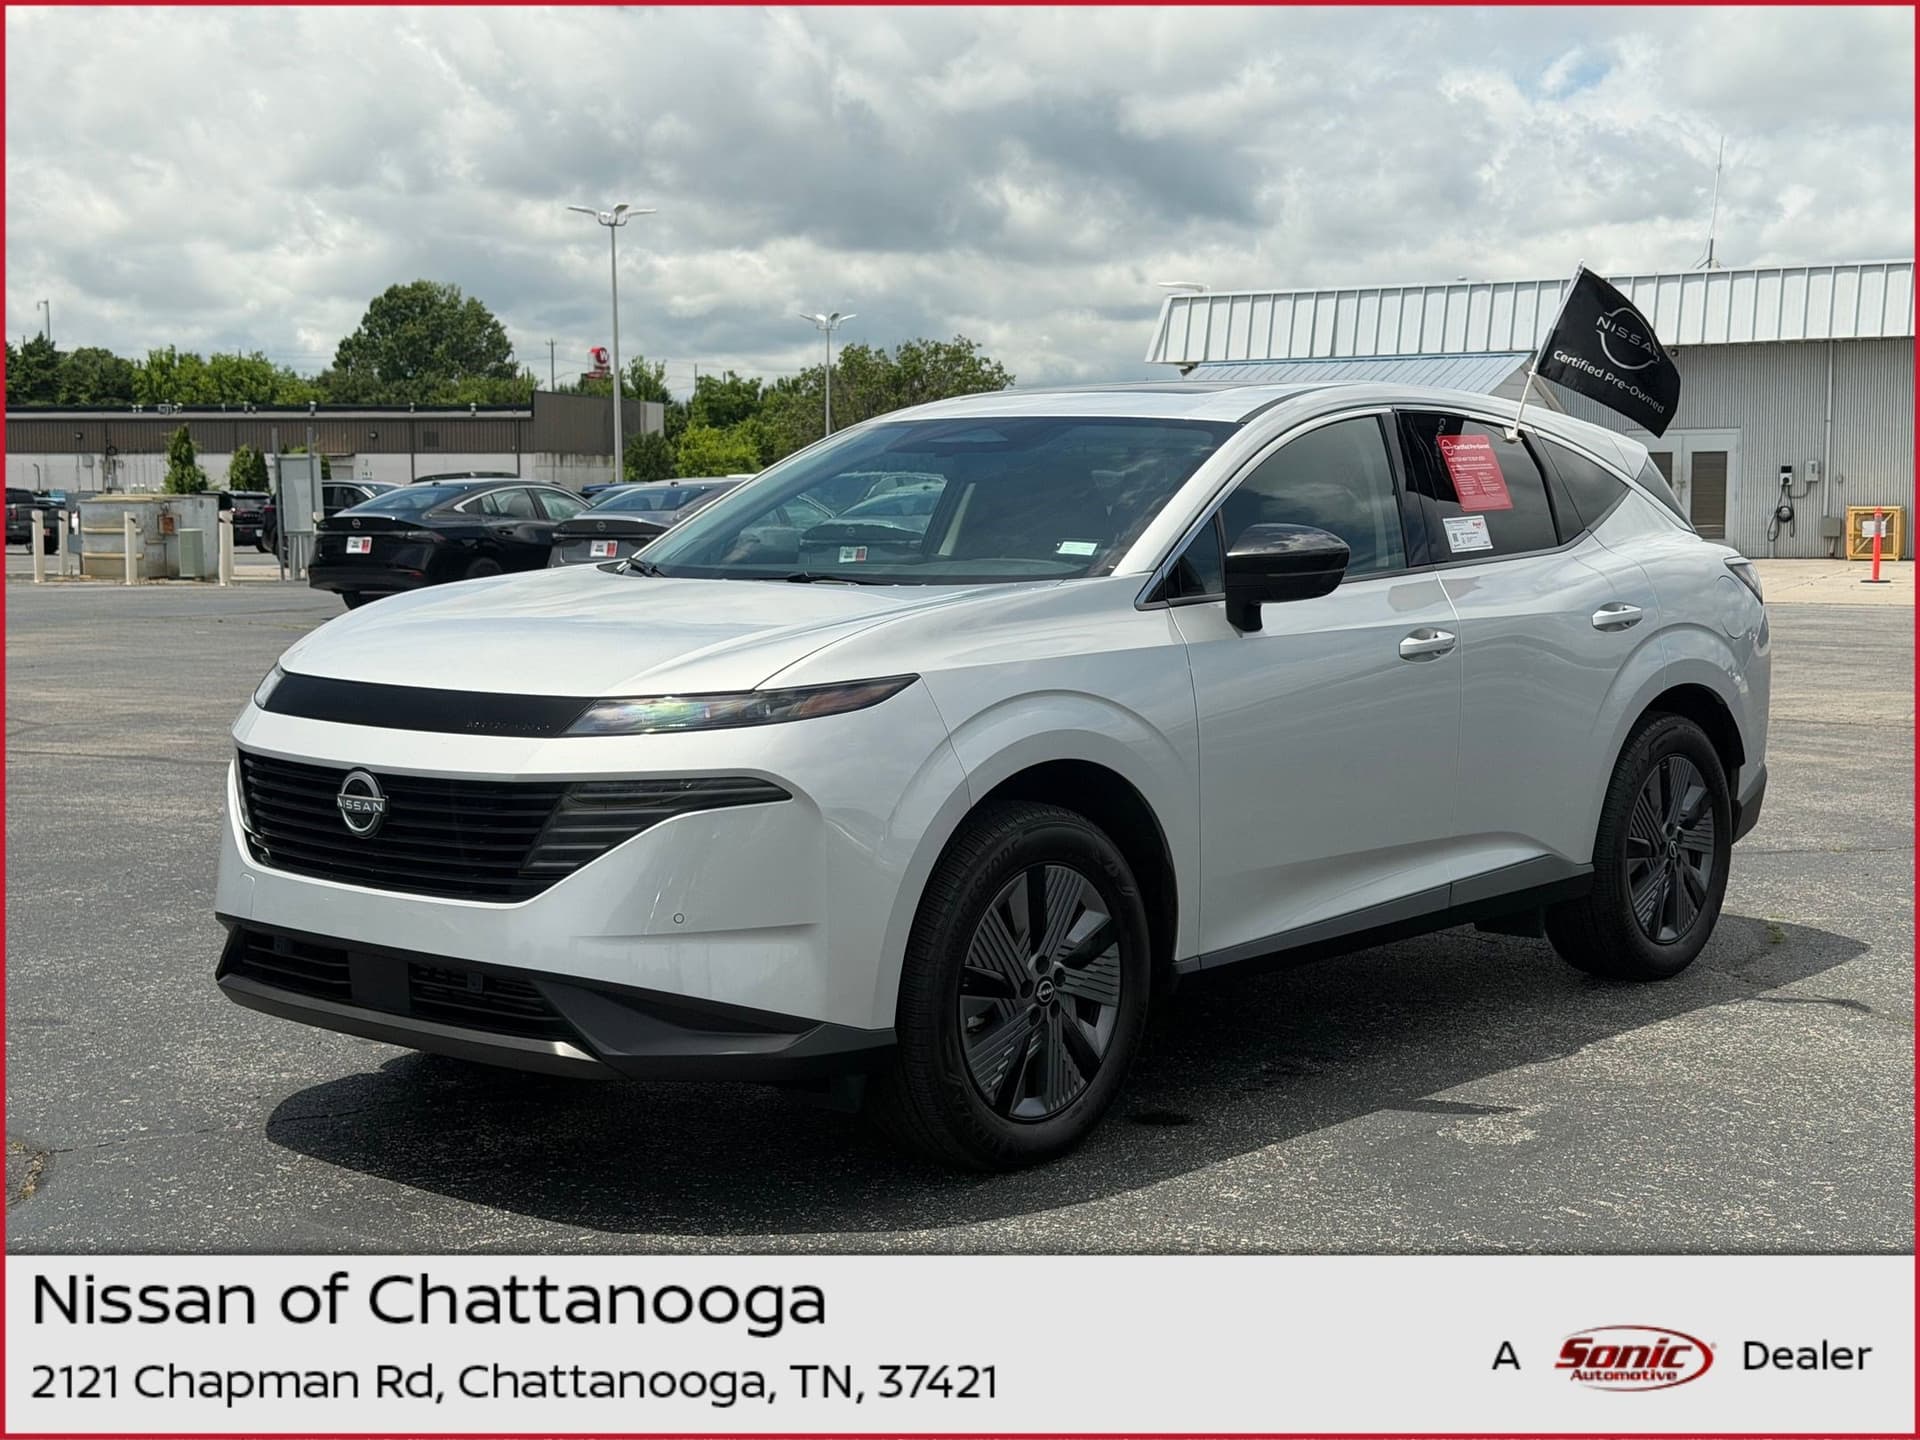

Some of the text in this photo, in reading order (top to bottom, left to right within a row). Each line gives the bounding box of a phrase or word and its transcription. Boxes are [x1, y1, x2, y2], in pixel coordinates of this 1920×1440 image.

[1553, 350, 1665, 414] Certified Pre-Owned
[337, 796, 383, 812] NISSAN
